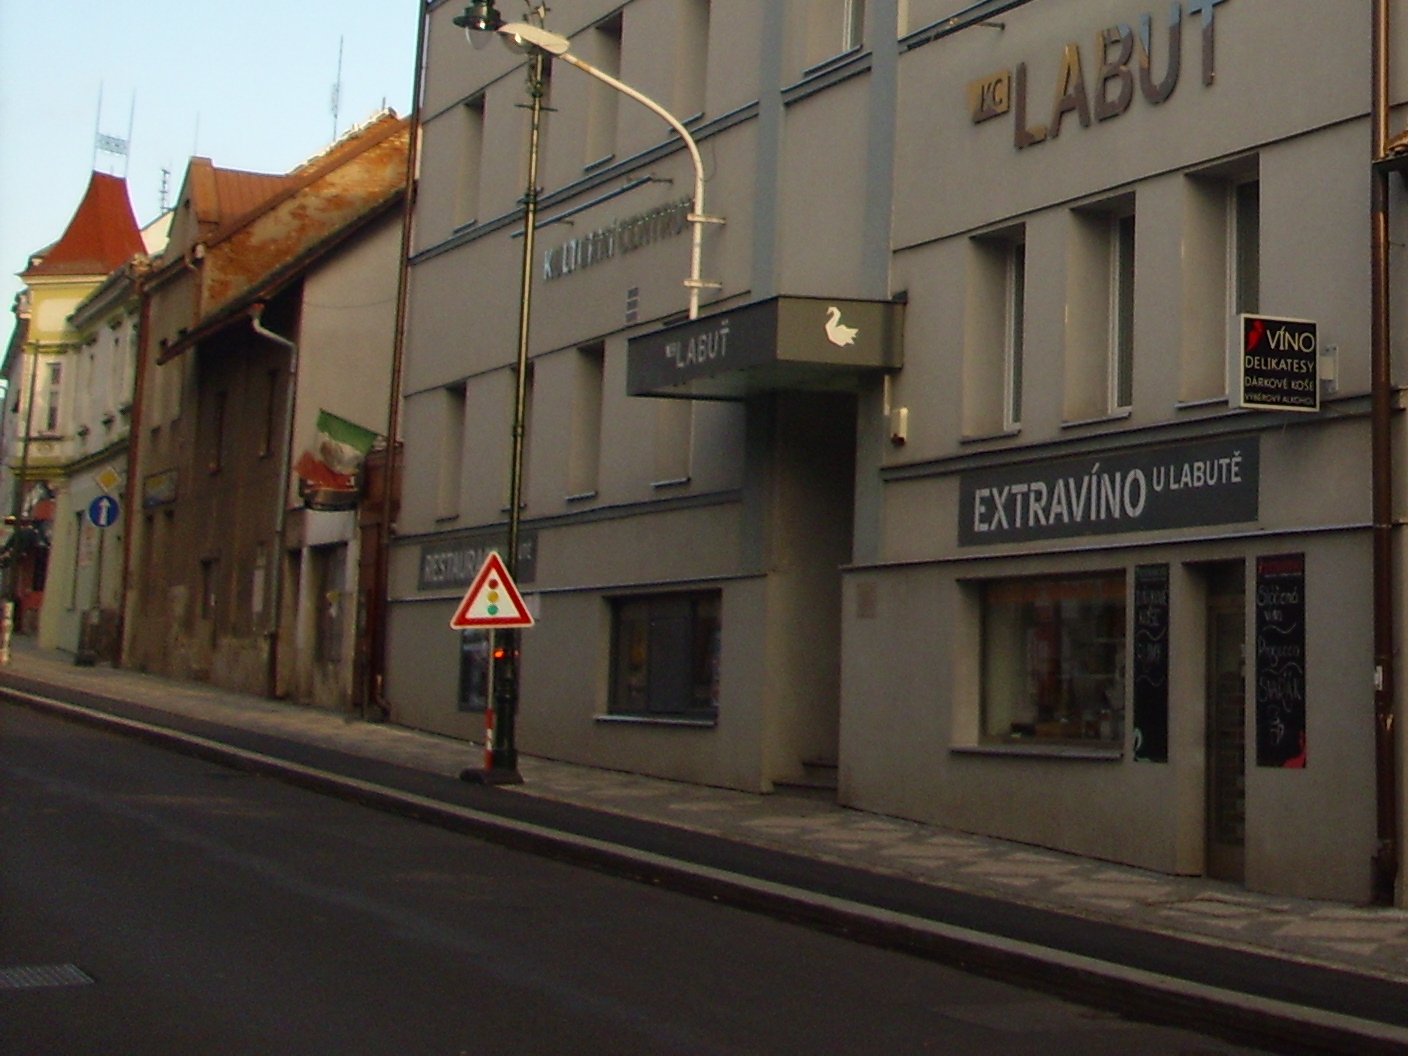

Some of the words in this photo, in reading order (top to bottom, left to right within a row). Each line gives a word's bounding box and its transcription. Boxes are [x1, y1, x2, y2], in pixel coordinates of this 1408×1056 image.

[1266, 325, 1315, 353] VÍNO
[1245, 355, 1314, 372] DELIKATESY
[1245, 376, 1288, 390] DÁRKOVÉ
[1291, 377, 1315, 392] KOŠE
[974, 462, 1147, 532] EXTRAVÍNO
[1152, 466, 1165, 492] U
[1168, 450, 1242, 491] LABUTĚ
